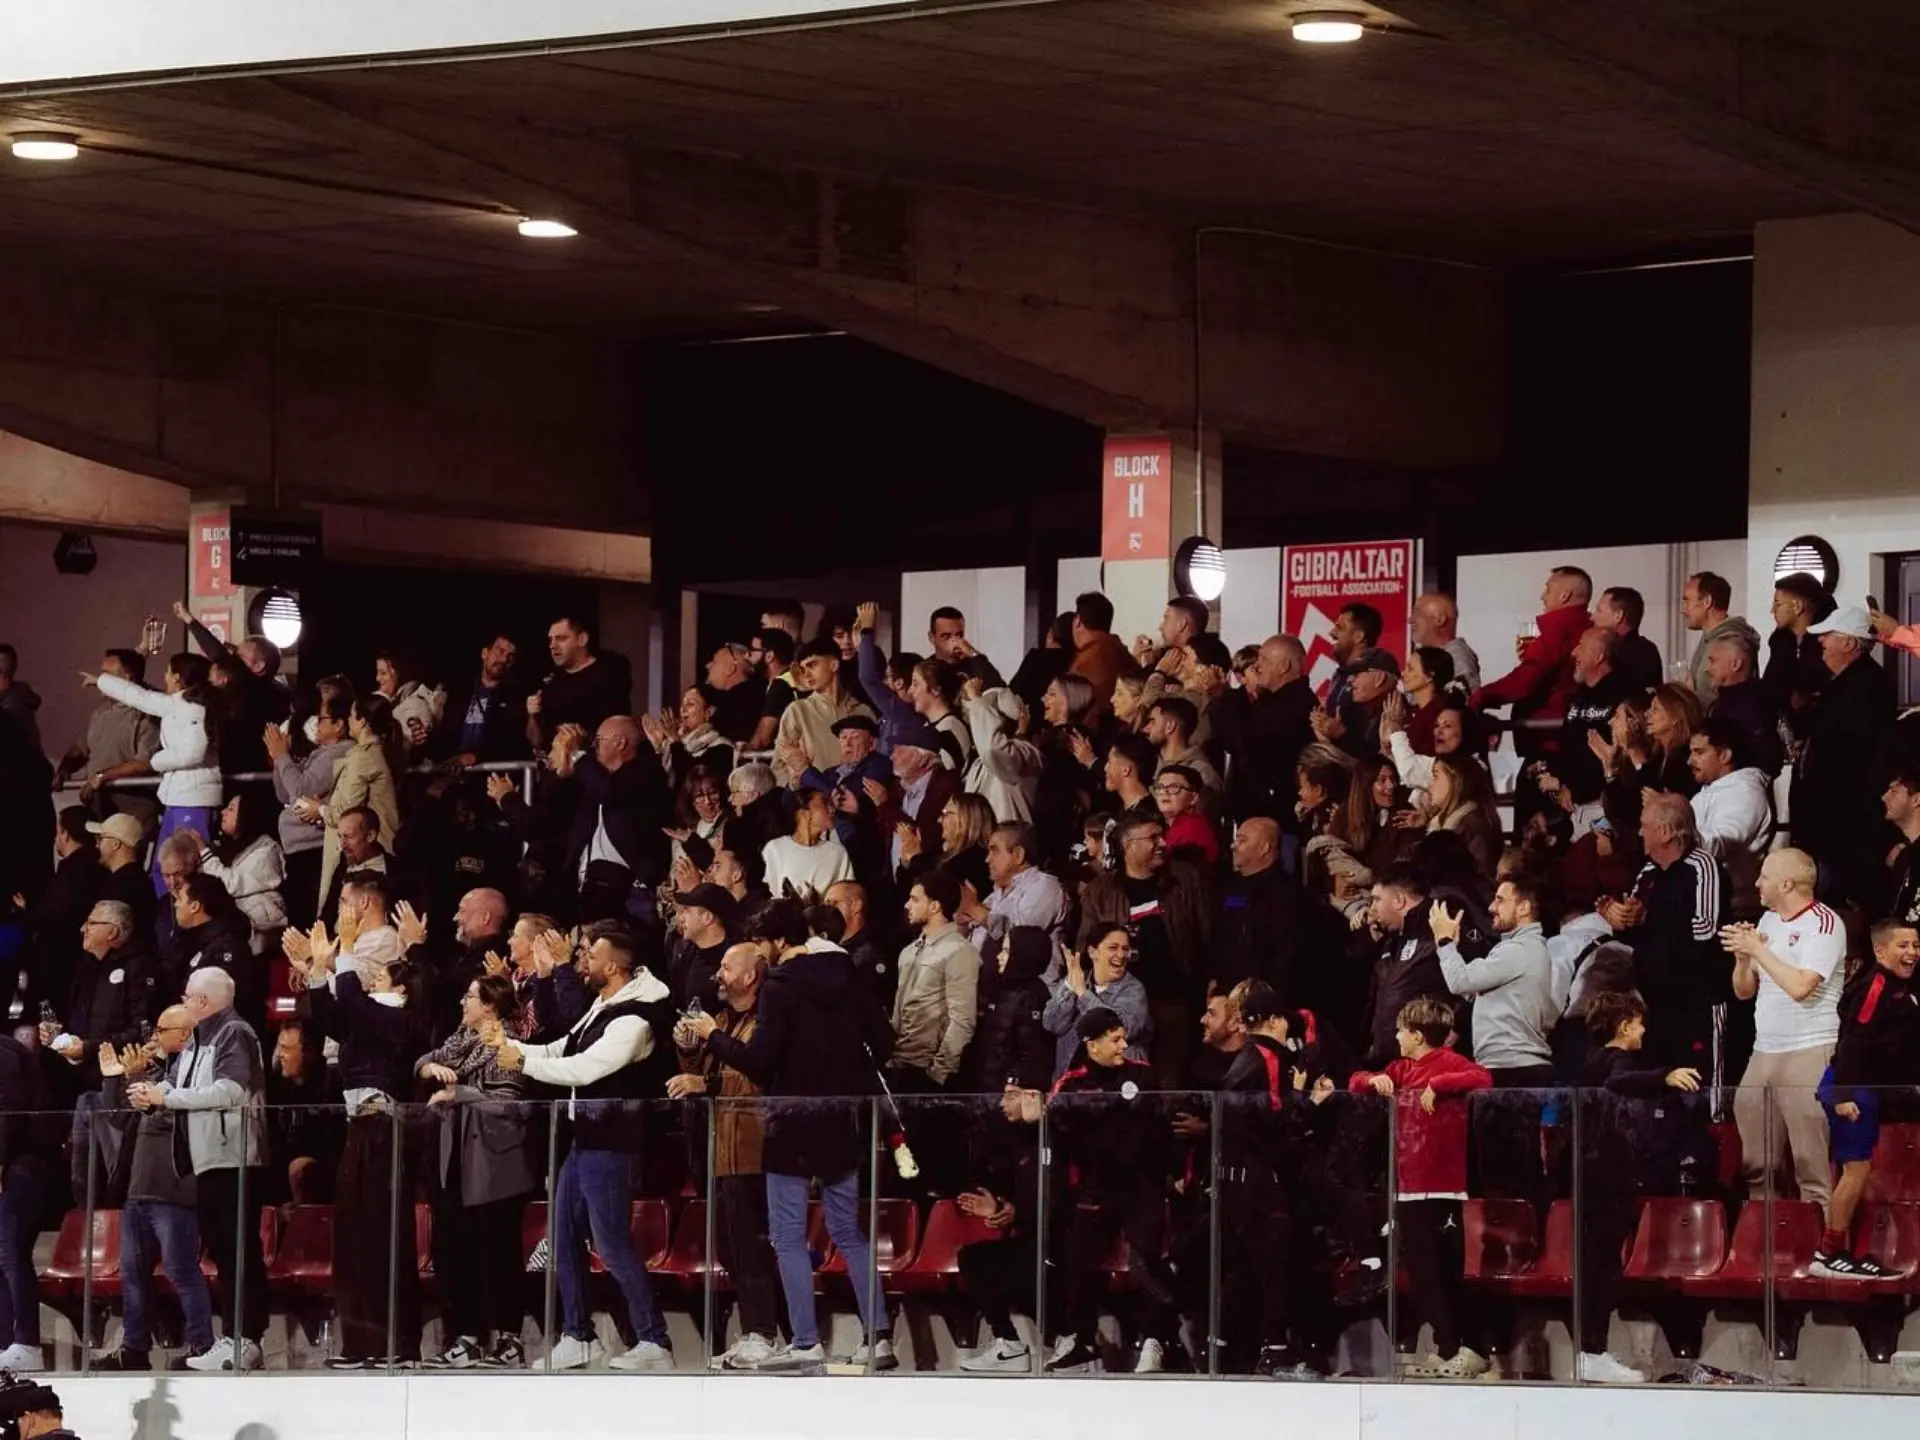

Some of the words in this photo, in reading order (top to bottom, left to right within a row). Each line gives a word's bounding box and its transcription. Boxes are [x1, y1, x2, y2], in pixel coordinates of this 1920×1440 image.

[1113, 455, 1160, 477] BLOCK
[1128, 482, 1144, 518] H
[210, 545, 221, 569] G
[1290, 548, 1405, 582] GIBRALTAR
